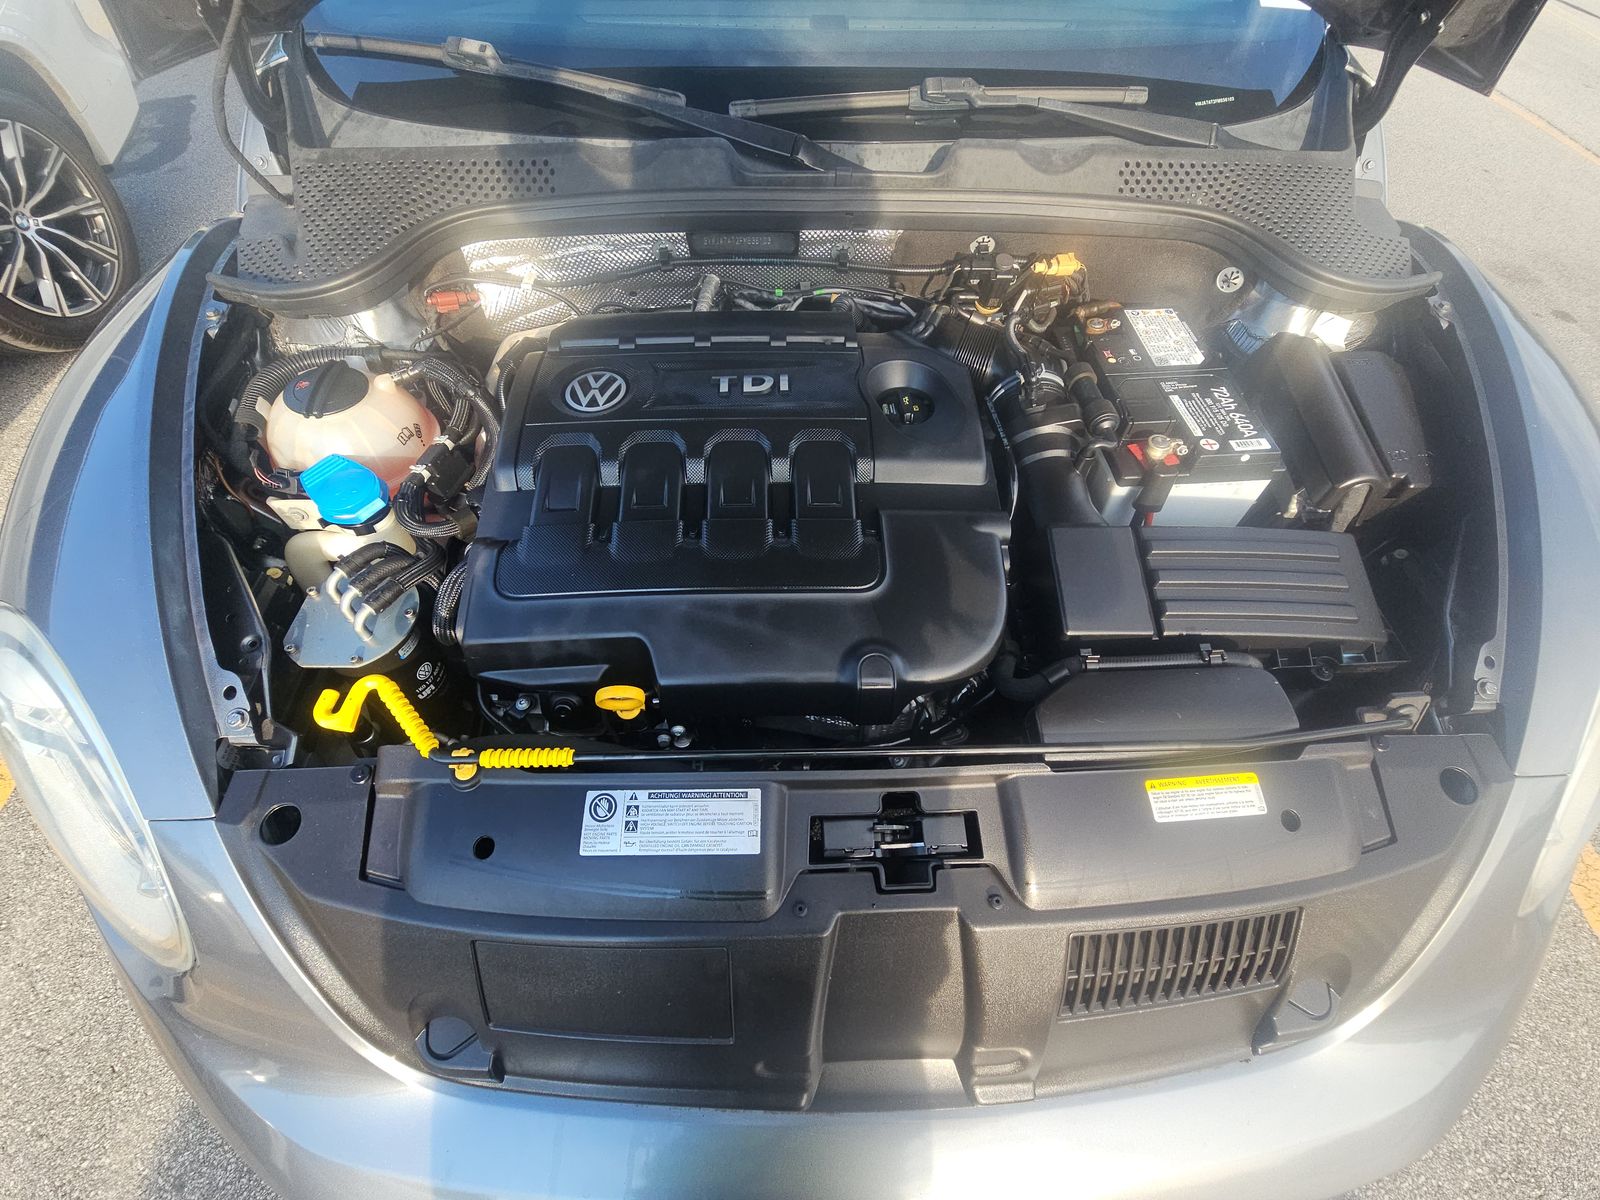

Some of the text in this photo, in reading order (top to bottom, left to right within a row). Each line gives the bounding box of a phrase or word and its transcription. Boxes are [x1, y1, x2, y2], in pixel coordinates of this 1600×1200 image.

[711, 374, 789, 396] TDI
[1210, 386, 1238, 410] 72Ah
[1229, 412, 1258, 437] 640A
